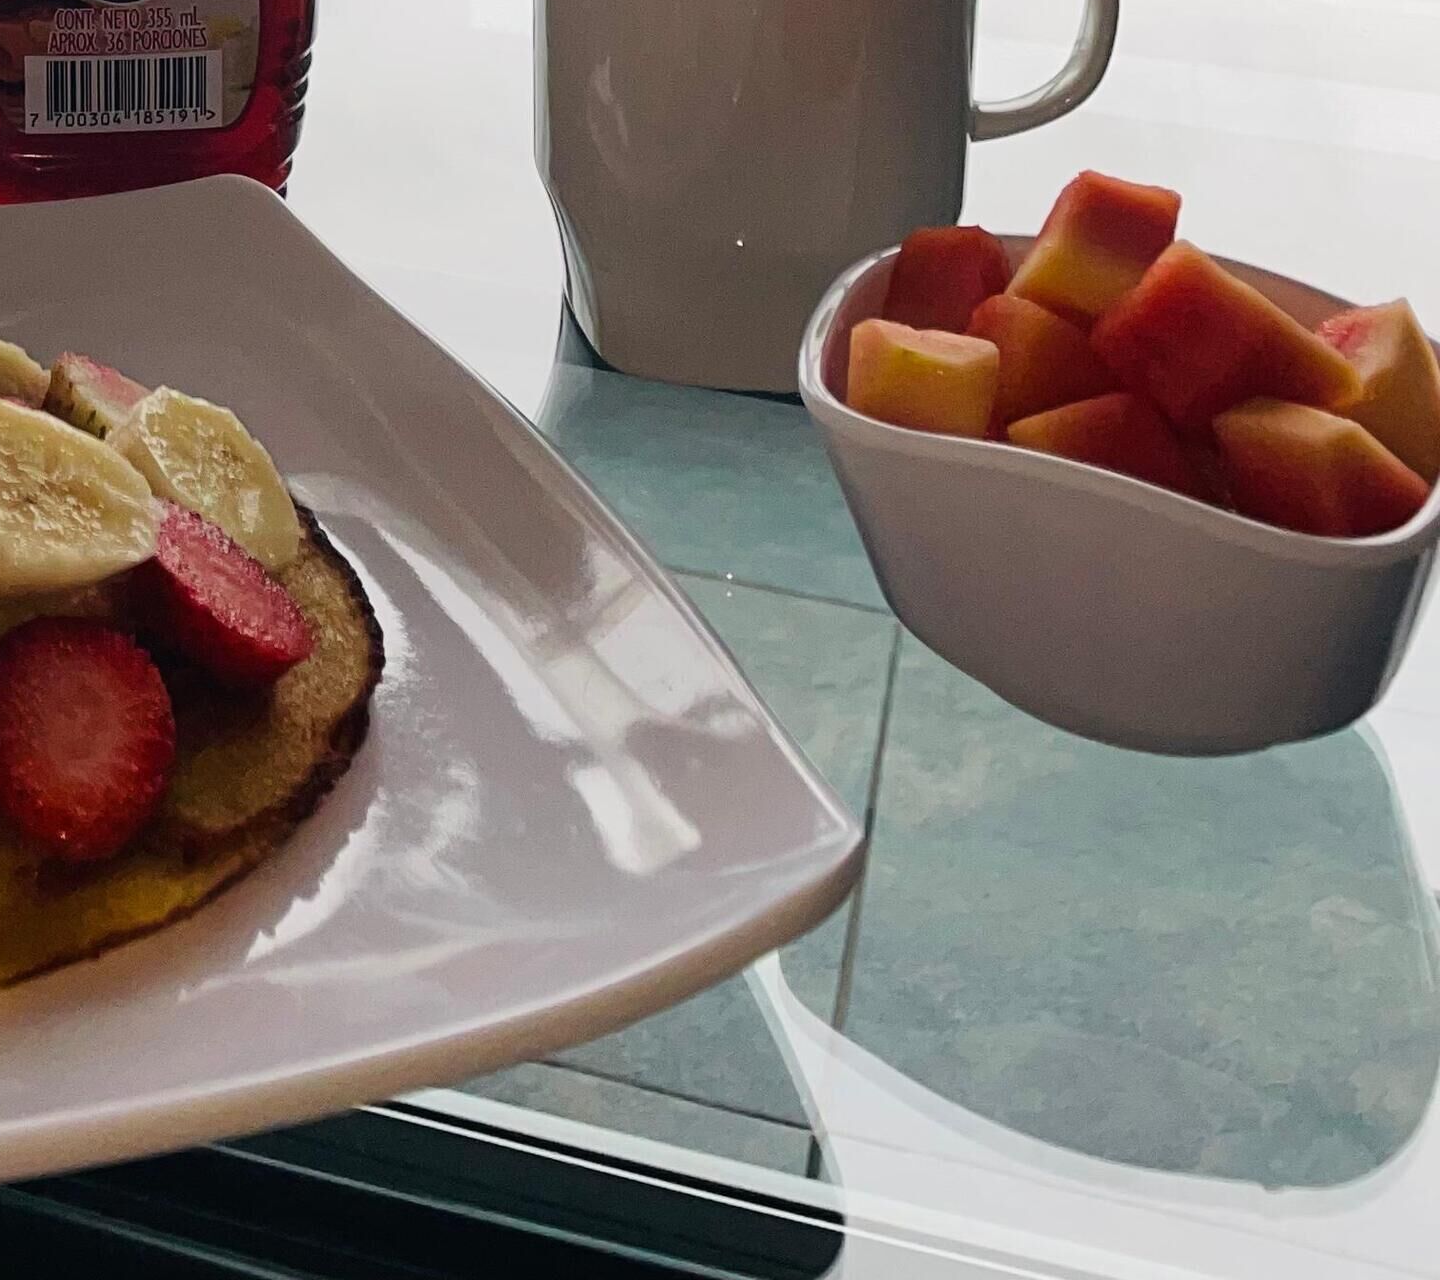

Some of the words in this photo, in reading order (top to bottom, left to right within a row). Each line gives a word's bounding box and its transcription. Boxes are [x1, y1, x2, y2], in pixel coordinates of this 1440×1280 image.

[55, 9, 95, 30] CONT.
[103, 9, 140, 29] NETO
[147, 8, 172, 27] 355
[180, 6, 201, 26] mL
[107, 32, 124, 50] 36
[132, 28, 207, 49] PORCIONES
[30, 113, 39, 127] 7
[55, 111, 121, 128] 700304
[134, 110, 199, 125] 185191
